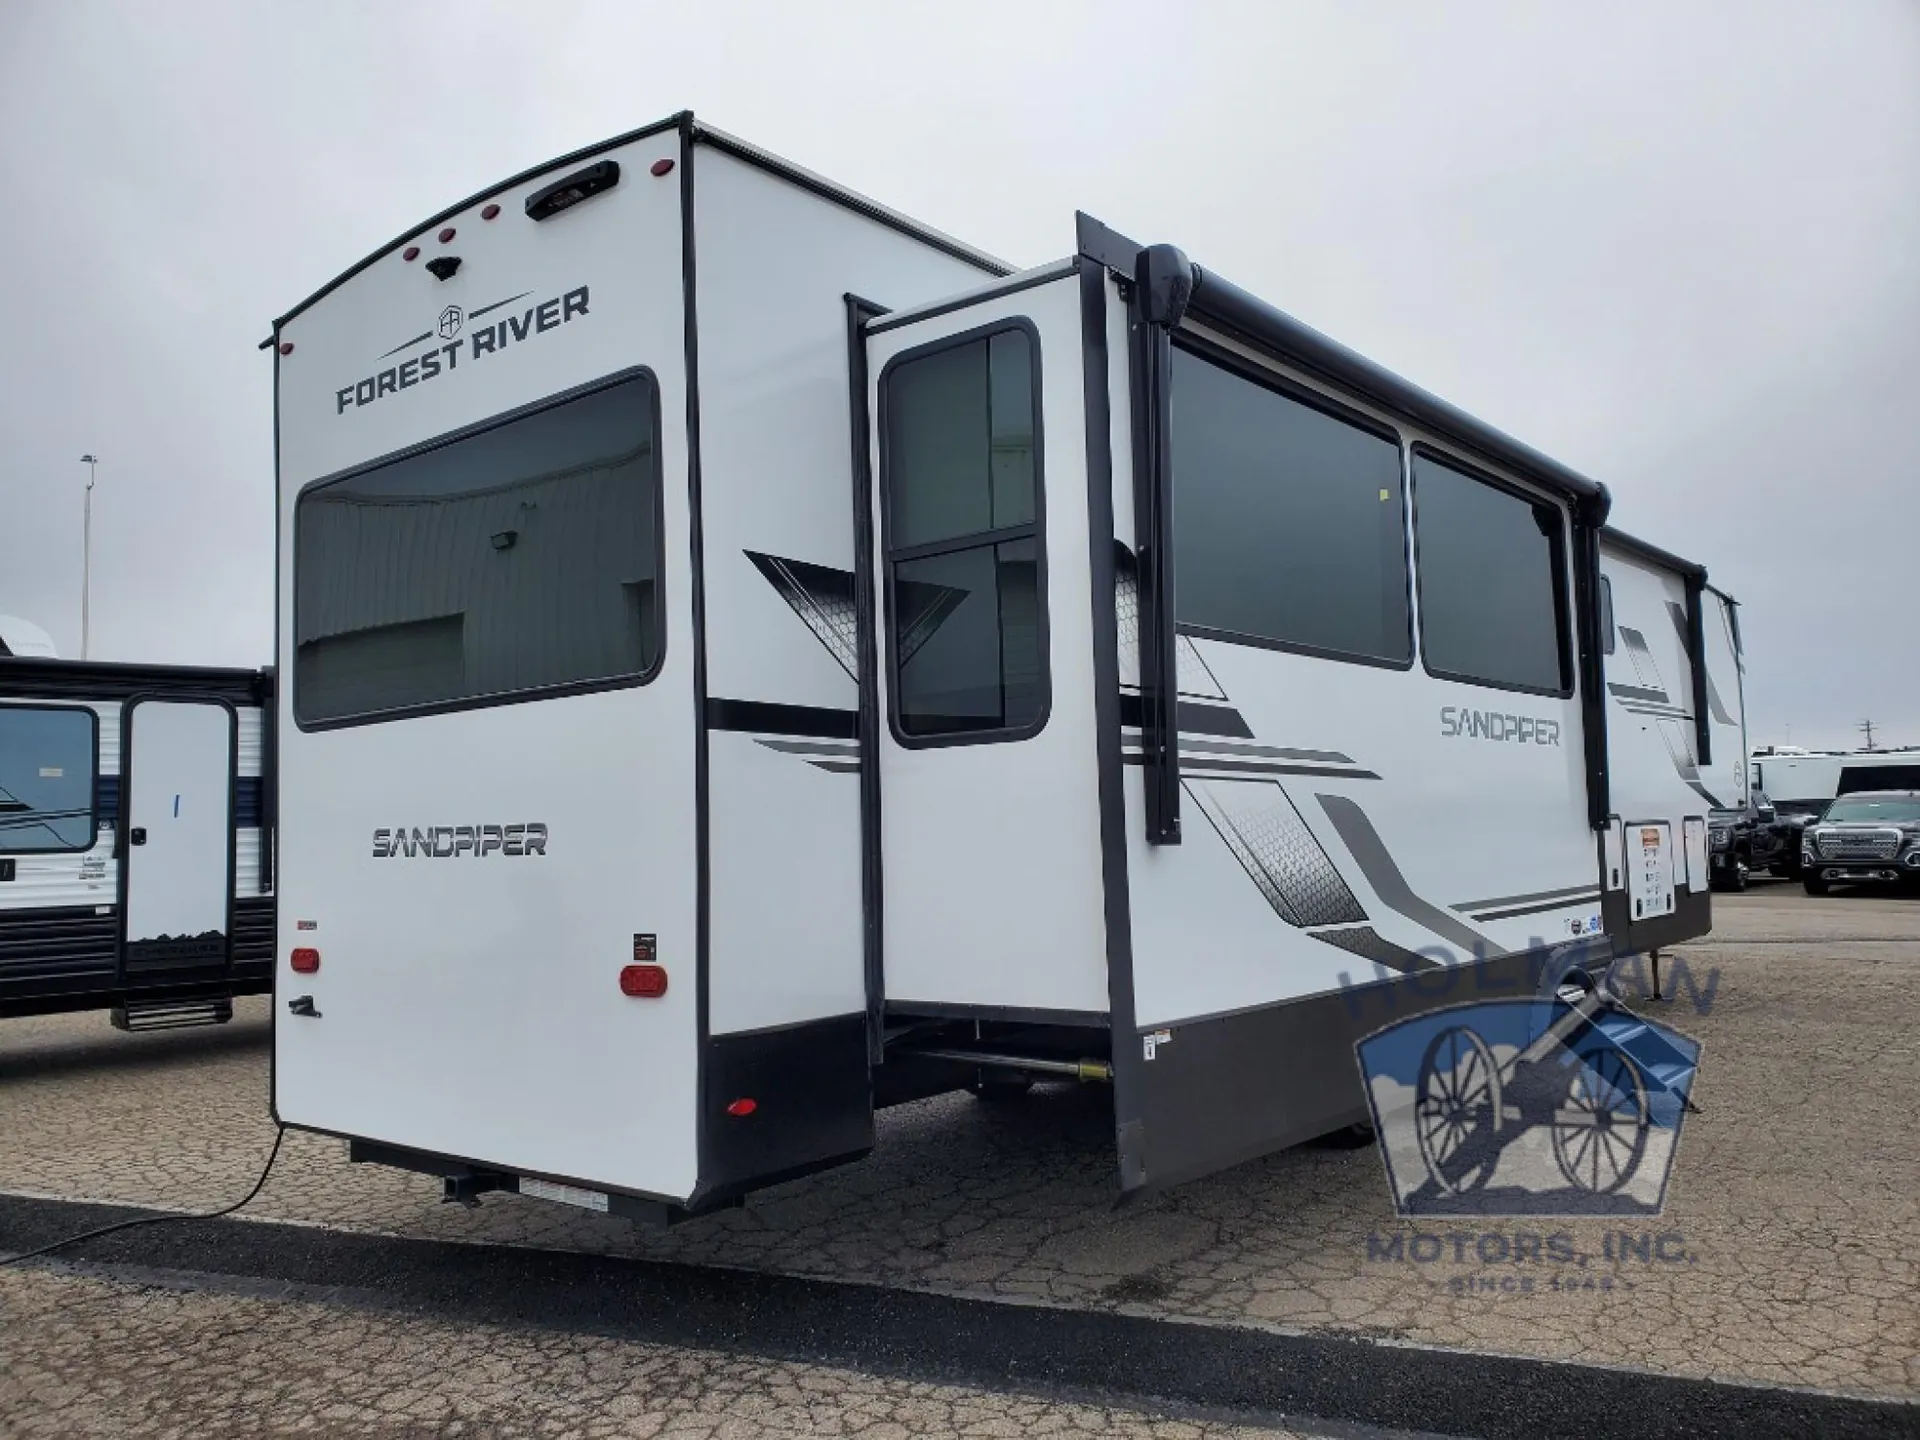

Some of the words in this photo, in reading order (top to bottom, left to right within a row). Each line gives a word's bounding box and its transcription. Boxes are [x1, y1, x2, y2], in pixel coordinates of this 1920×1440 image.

[335, 339, 463, 415] FOREST
[472, 285, 590, 360] RIVER
[1441, 706, 1559, 746] SANDPIPER
[372, 822, 548, 858] SANDPIPER
